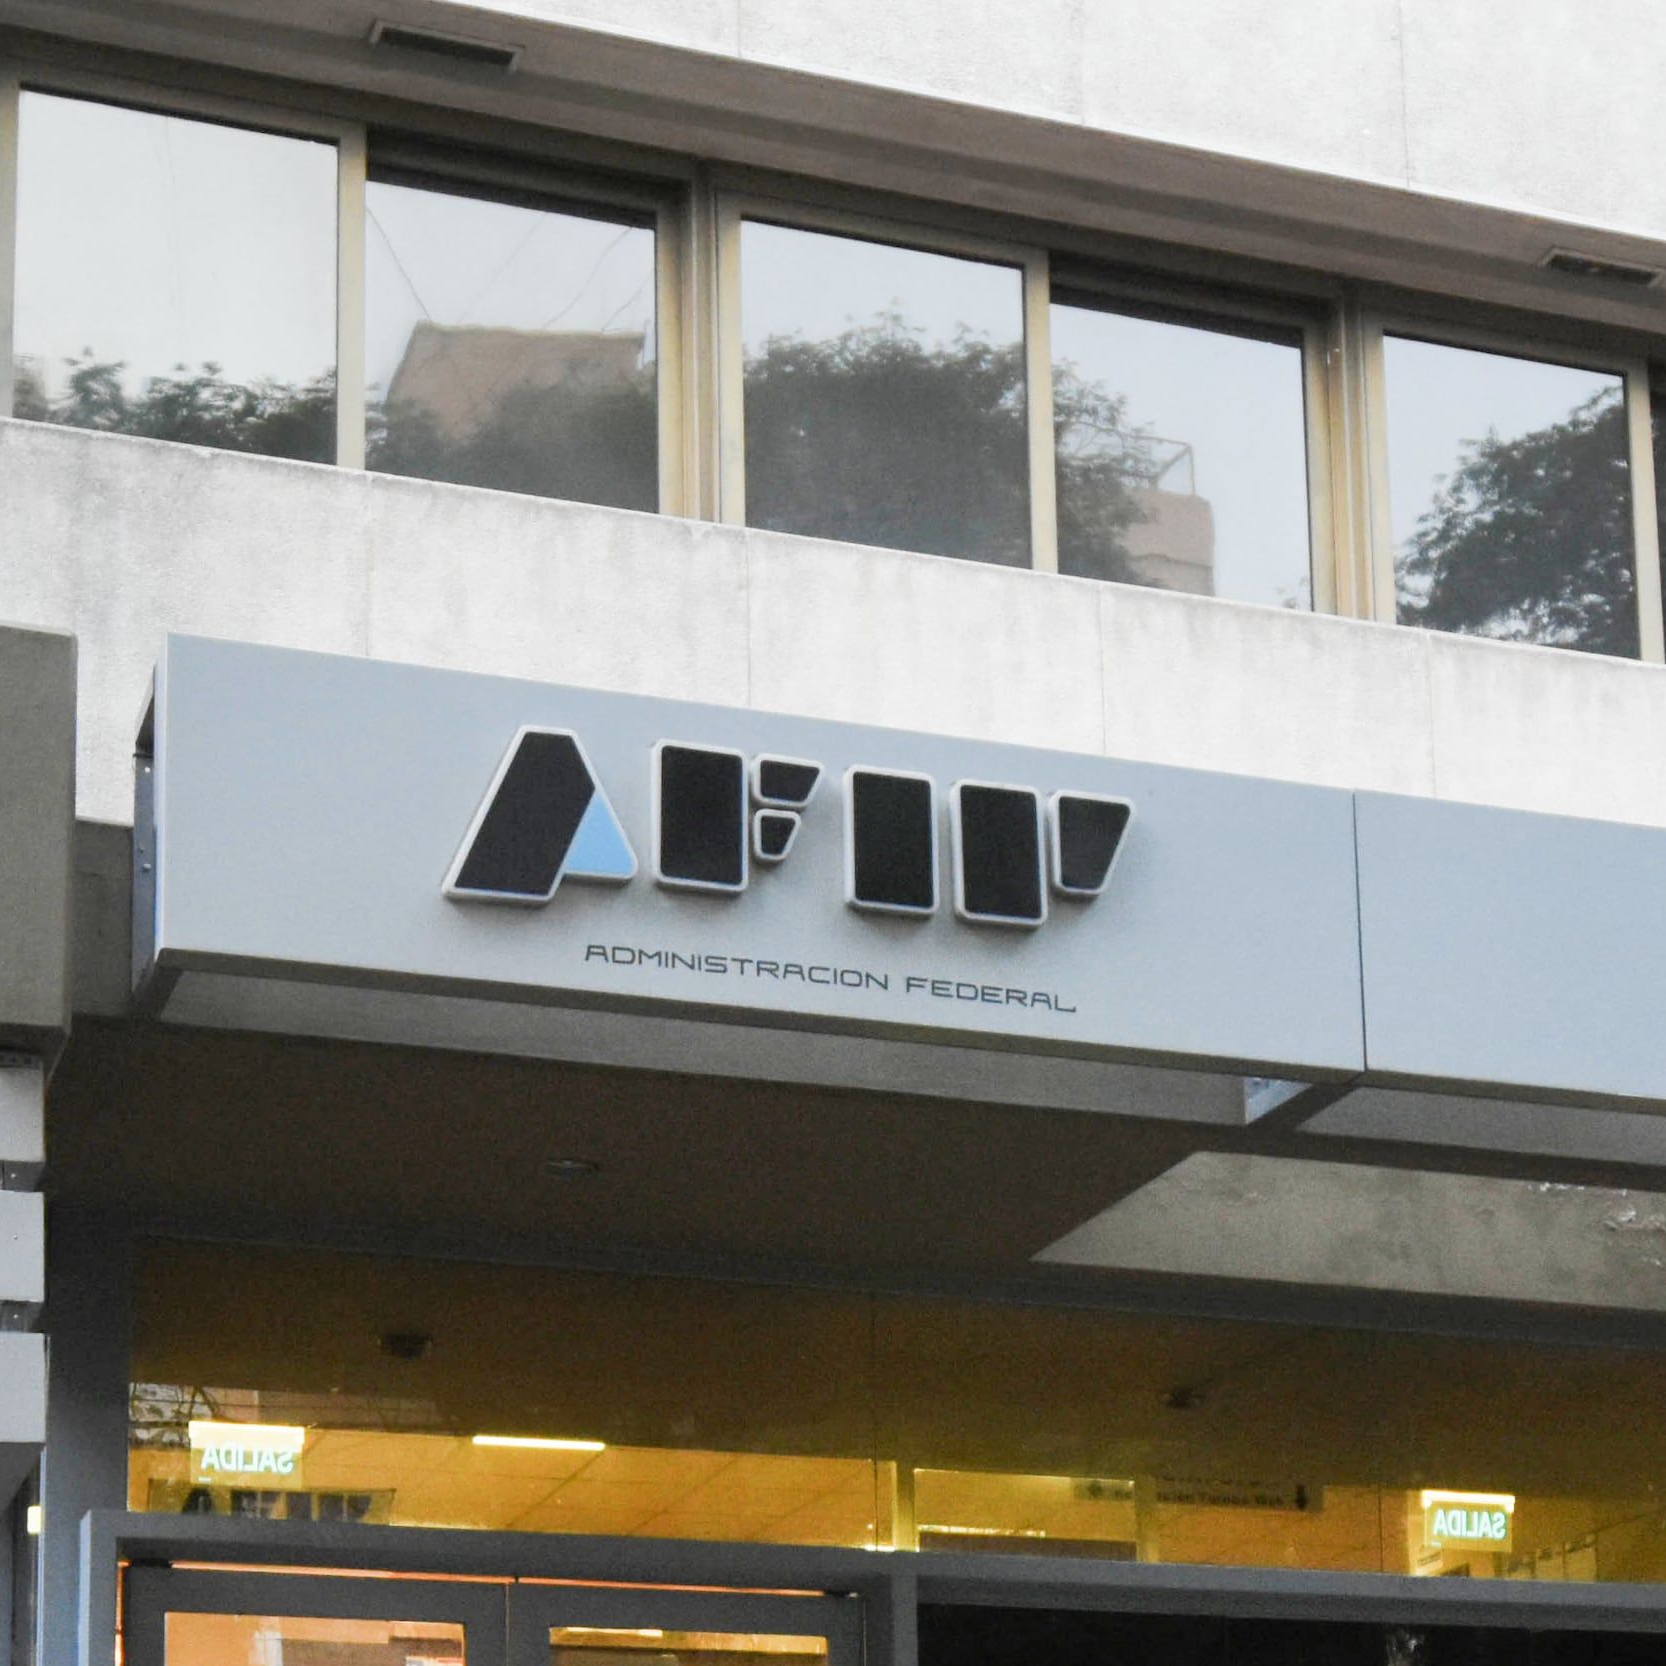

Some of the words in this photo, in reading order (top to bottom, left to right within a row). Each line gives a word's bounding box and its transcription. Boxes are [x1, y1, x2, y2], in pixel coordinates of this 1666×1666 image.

[441, 724, 1136, 925] AFIP
[584, 944, 889, 991] ADMINISTRACION
[905, 976, 1077, 1013] FEDERAL
